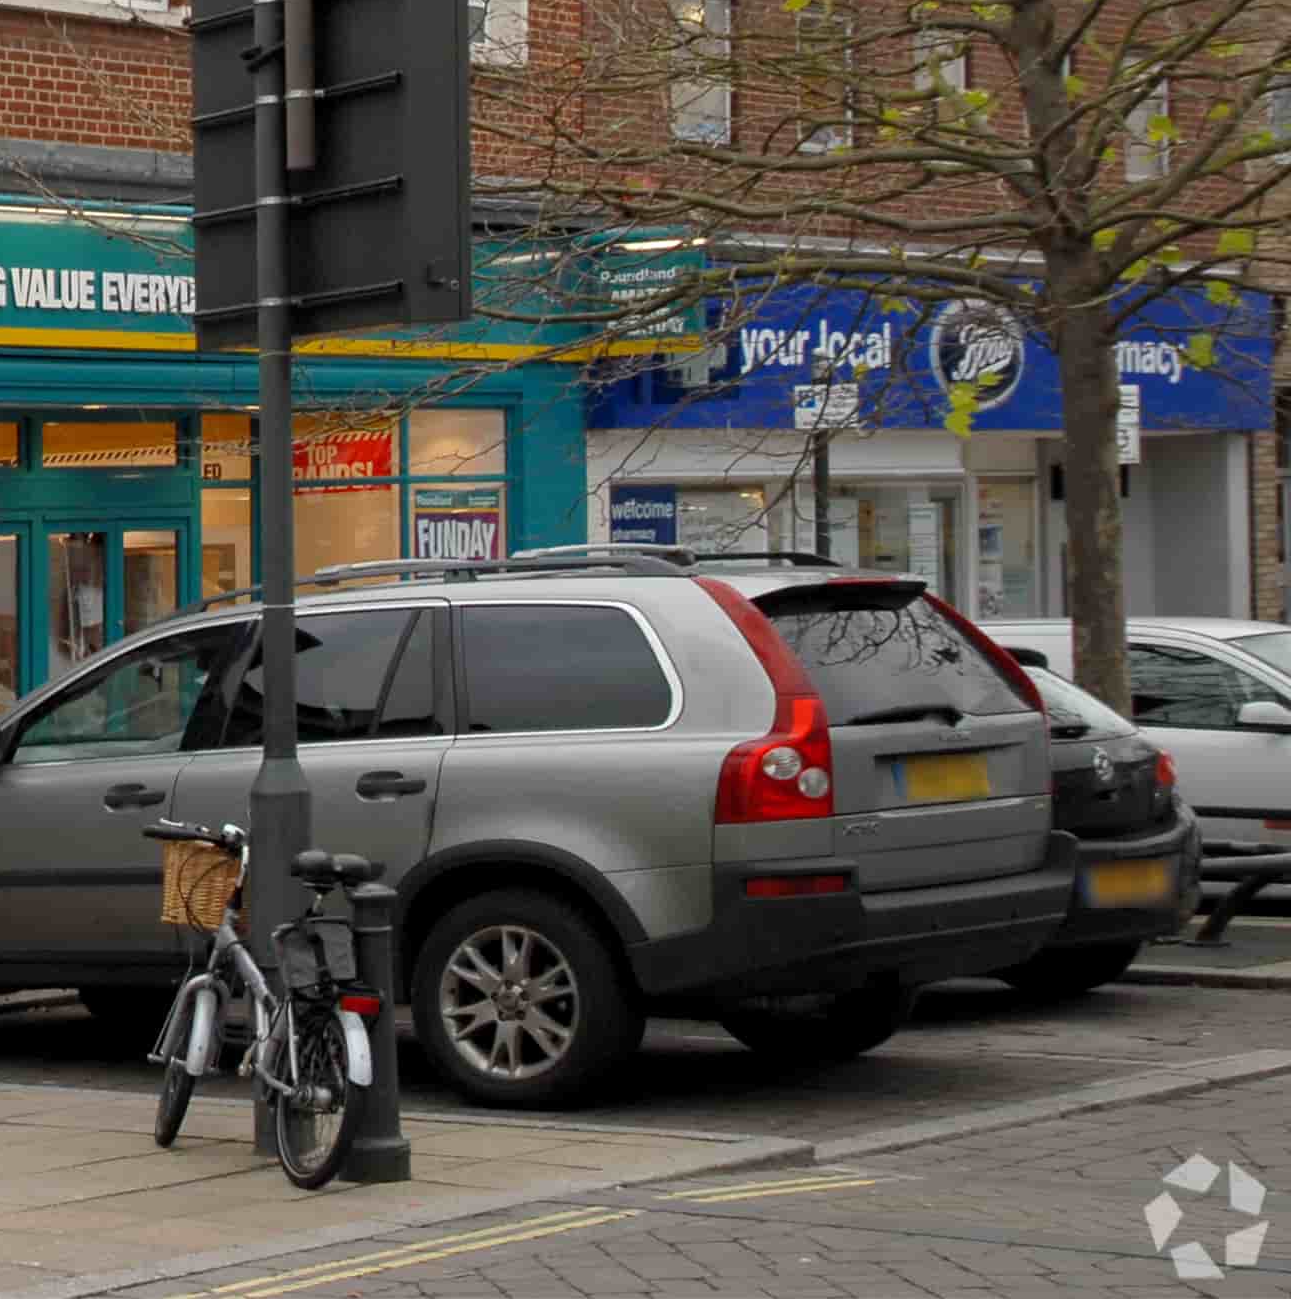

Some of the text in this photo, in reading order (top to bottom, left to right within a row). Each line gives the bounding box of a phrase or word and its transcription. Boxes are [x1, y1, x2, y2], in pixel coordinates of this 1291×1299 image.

[11, 267, 96, 311] VALUE
[102, 272, 195, 314] EVERYD
[740, 327, 809, 374] your
[820, 319, 891, 368] local
[1116, 341, 1185, 384] macy
[307, 444, 338, 465] TOP
[292, 461, 374, 492] RANDS!
[611, 498, 675, 519] welcome
